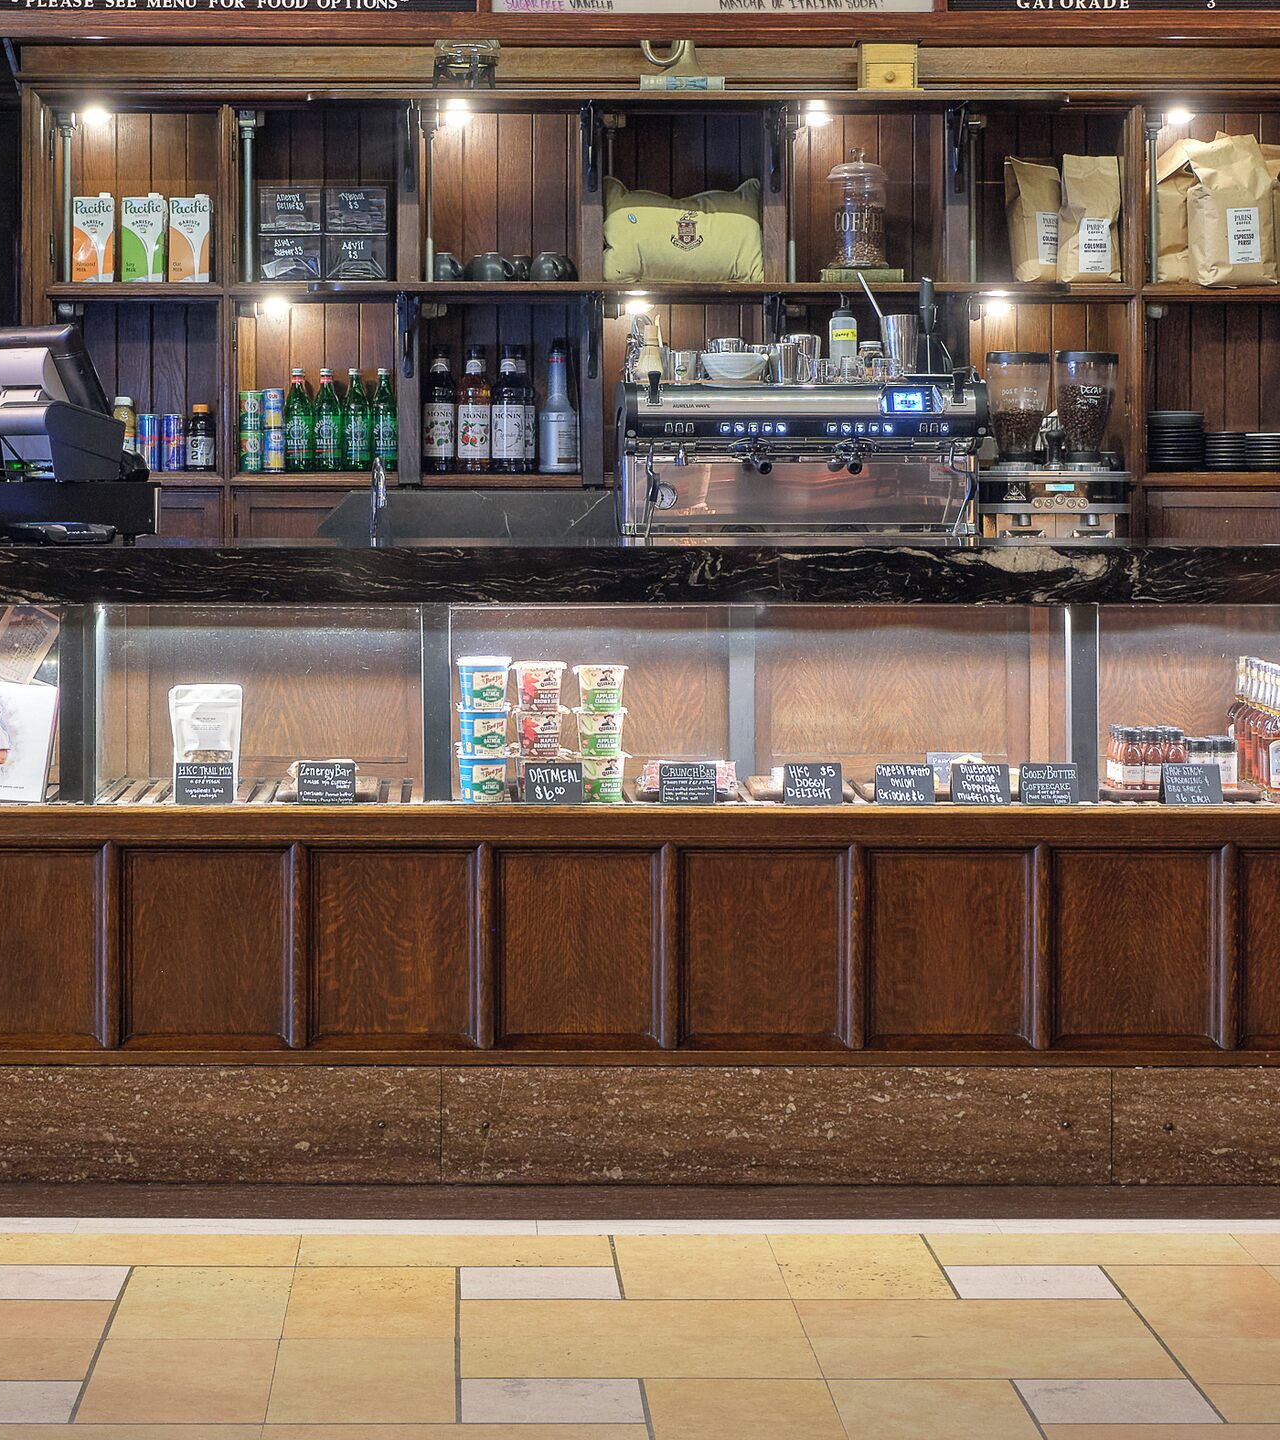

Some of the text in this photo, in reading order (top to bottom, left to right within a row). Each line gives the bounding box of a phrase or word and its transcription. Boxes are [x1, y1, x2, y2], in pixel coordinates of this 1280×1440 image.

[540, 0, 566, 10] FREE
[569, 0, 614, 10] VANILLA
[75, 199, 112, 214] Pacific
[124, 199, 162, 214] Pacific
[171, 199, 209, 214] Pacific
[178, 766, 232, 776] HKC TRAIL MIX
[529, 768, 581, 783] OATMEAL
[788, 765, 836, 778] HKC $5
[795, 778, 826, 789] DOGGY
[786, 787, 832, 799] DELIGHT
